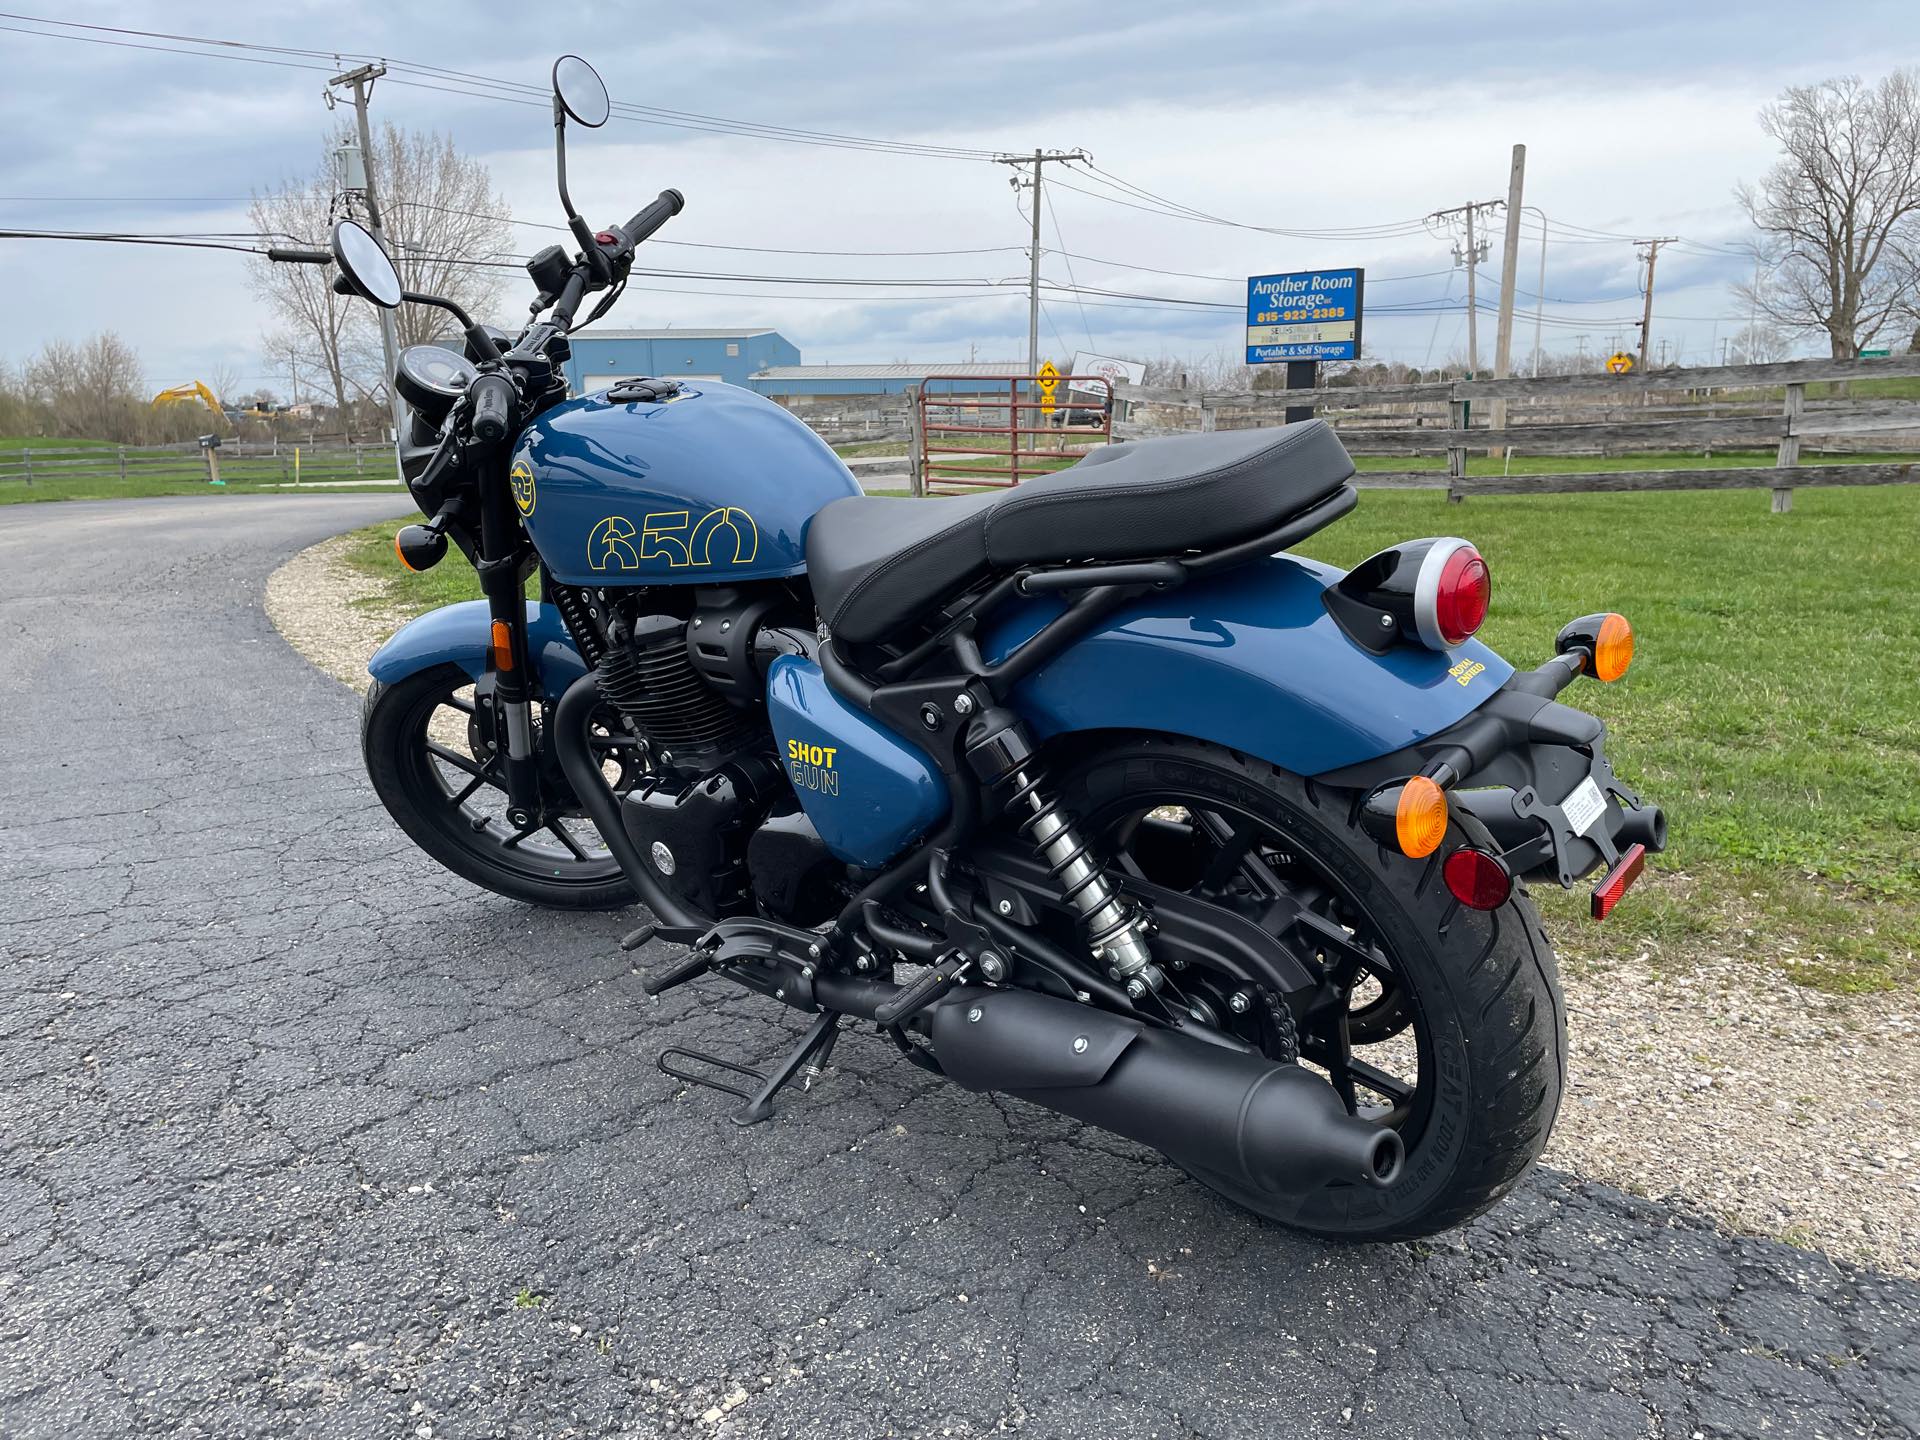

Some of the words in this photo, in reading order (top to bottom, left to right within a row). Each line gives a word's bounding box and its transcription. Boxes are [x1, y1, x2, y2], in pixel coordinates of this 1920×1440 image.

[1253, 277, 1308, 295] Another
[1311, 276, 1352, 291] Room
[1269, 293, 1324, 310] Storage
[1257, 307, 1345, 322] 815-923-2385
[1255, 347, 1287, 357] Portable
[1288, 347, 1295, 355] &
[1297, 344, 1313, 355] Self
[1313, 345, 1345, 356] Storage
[588, 507, 758, 570] 650
[1448, 658, 1474, 677] ROYAL
[1456, 662, 1486, 687] ENFIELD
[788, 739, 837, 768] SHOT
[790, 760, 839, 796] GUN
